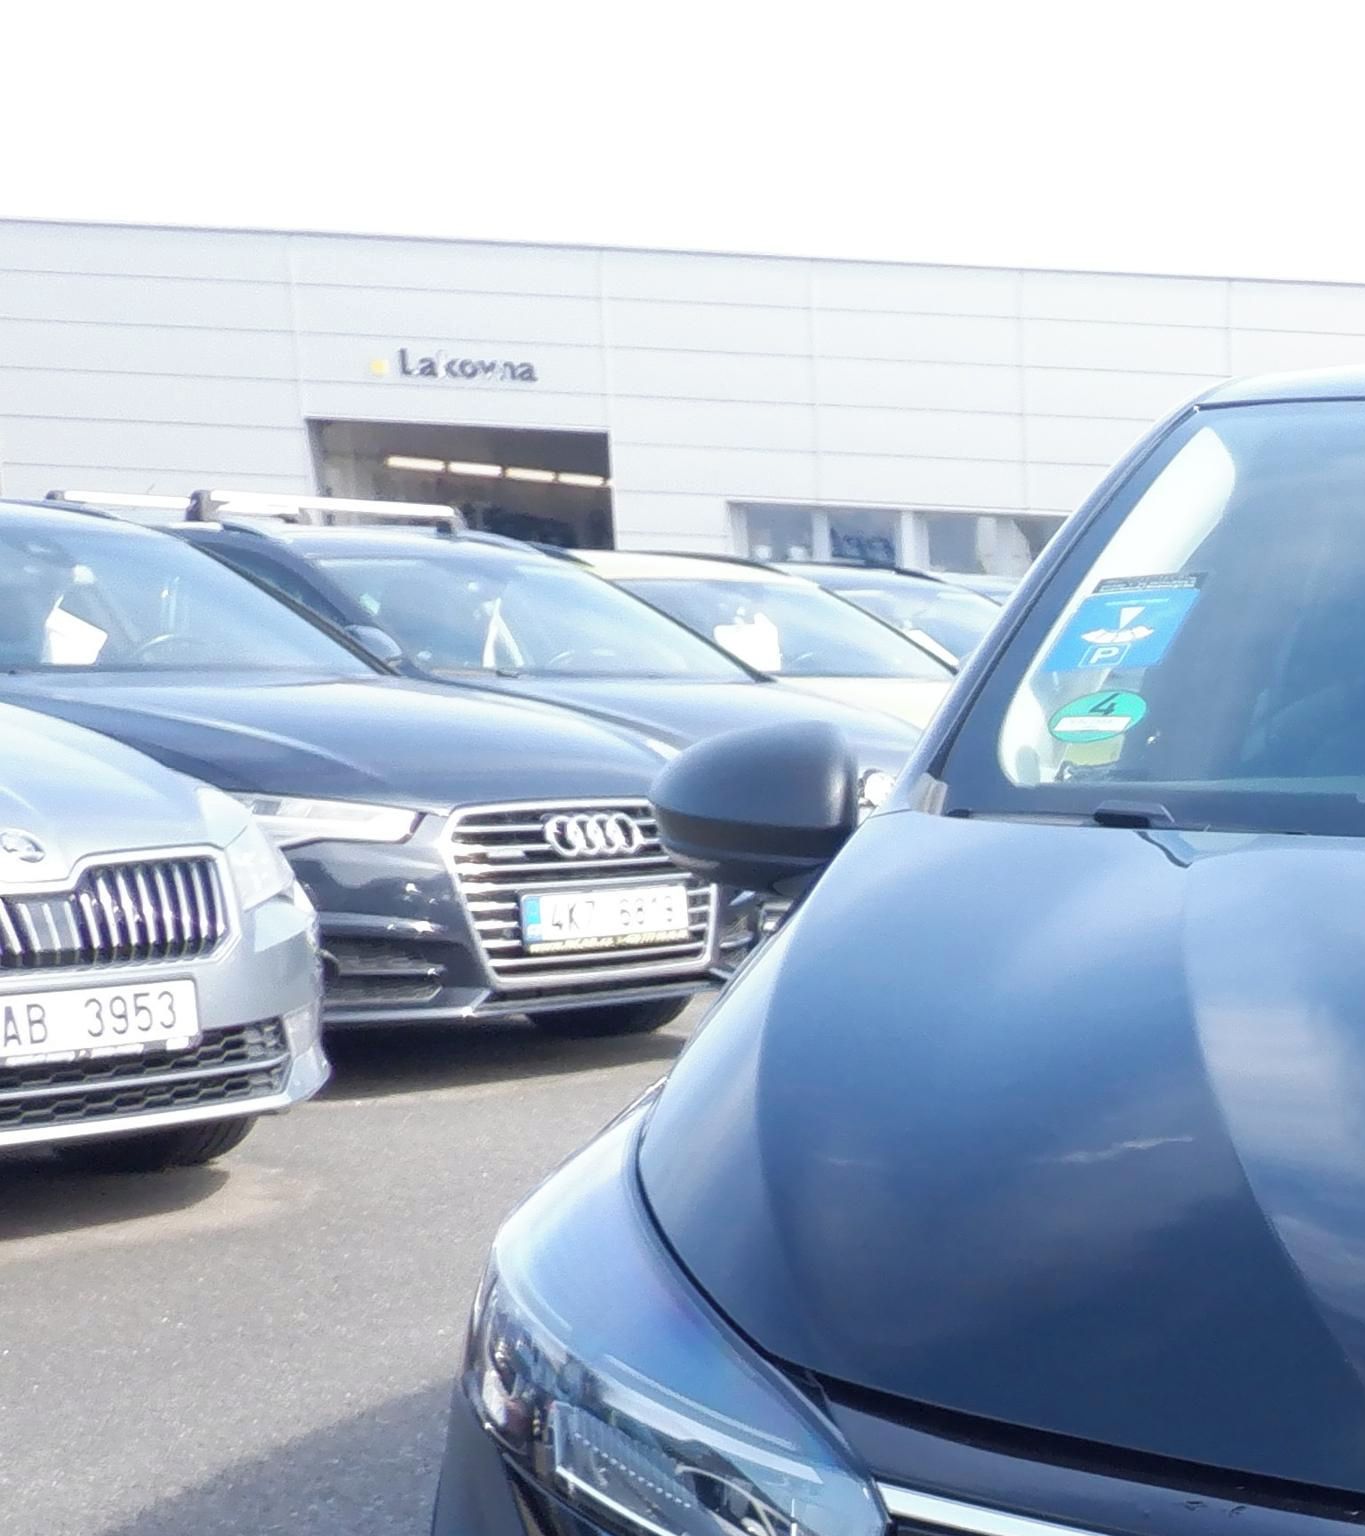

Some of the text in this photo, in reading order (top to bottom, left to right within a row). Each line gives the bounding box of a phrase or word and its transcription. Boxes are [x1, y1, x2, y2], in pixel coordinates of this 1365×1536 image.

[1089, 647, 1120, 664] P
[1089, 693, 1119, 715] 4
[4, 991, 176, 1047] AB 3953
